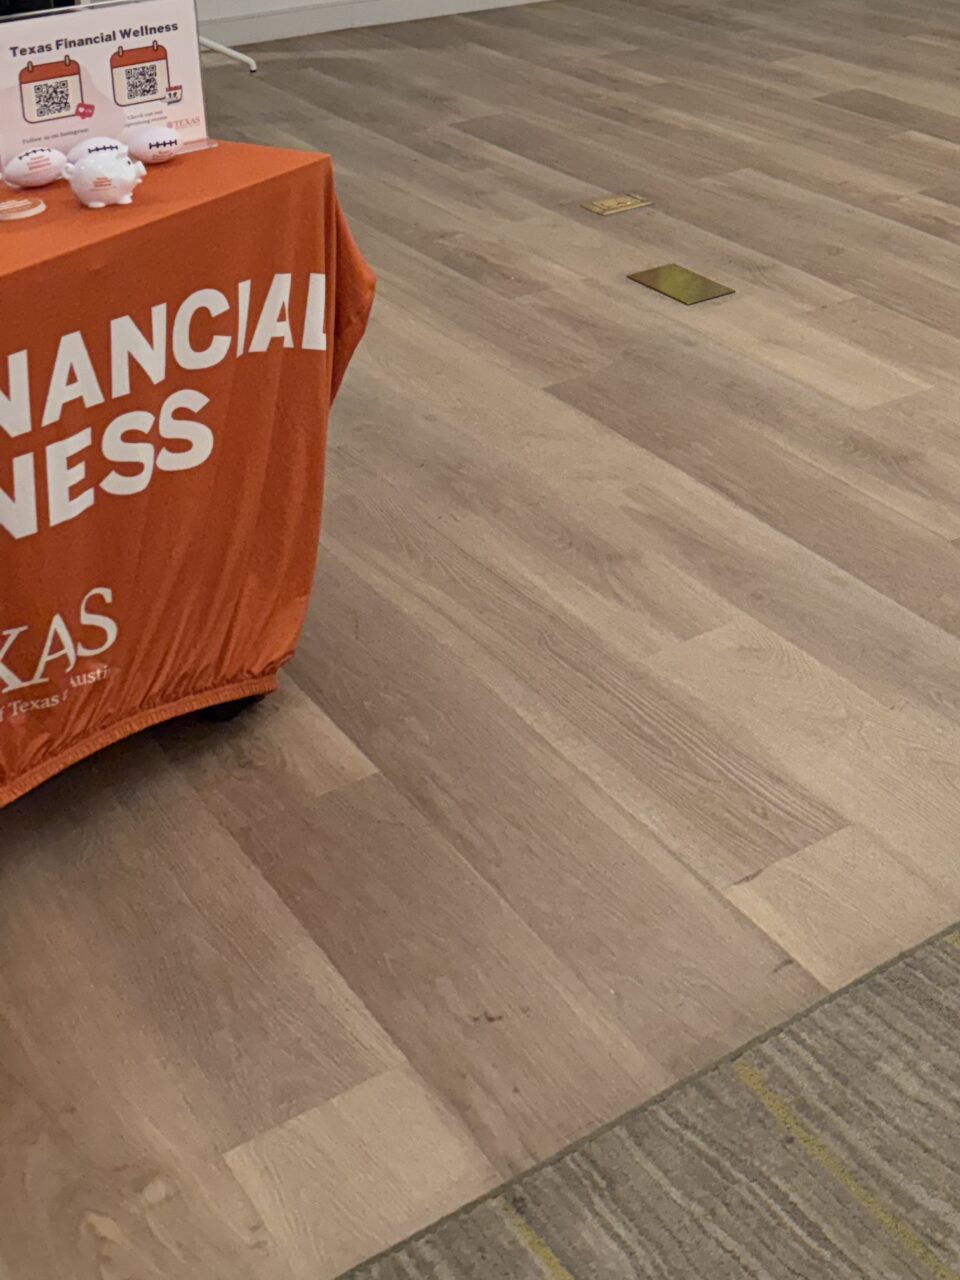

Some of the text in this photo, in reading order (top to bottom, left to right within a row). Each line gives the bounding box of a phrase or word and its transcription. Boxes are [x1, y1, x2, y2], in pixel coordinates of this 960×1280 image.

[10, 23, 179, 58] Texas Financial Wellness
[175, 116, 201, 129] TEXAS
[7, 693, 60, 718] Texas
